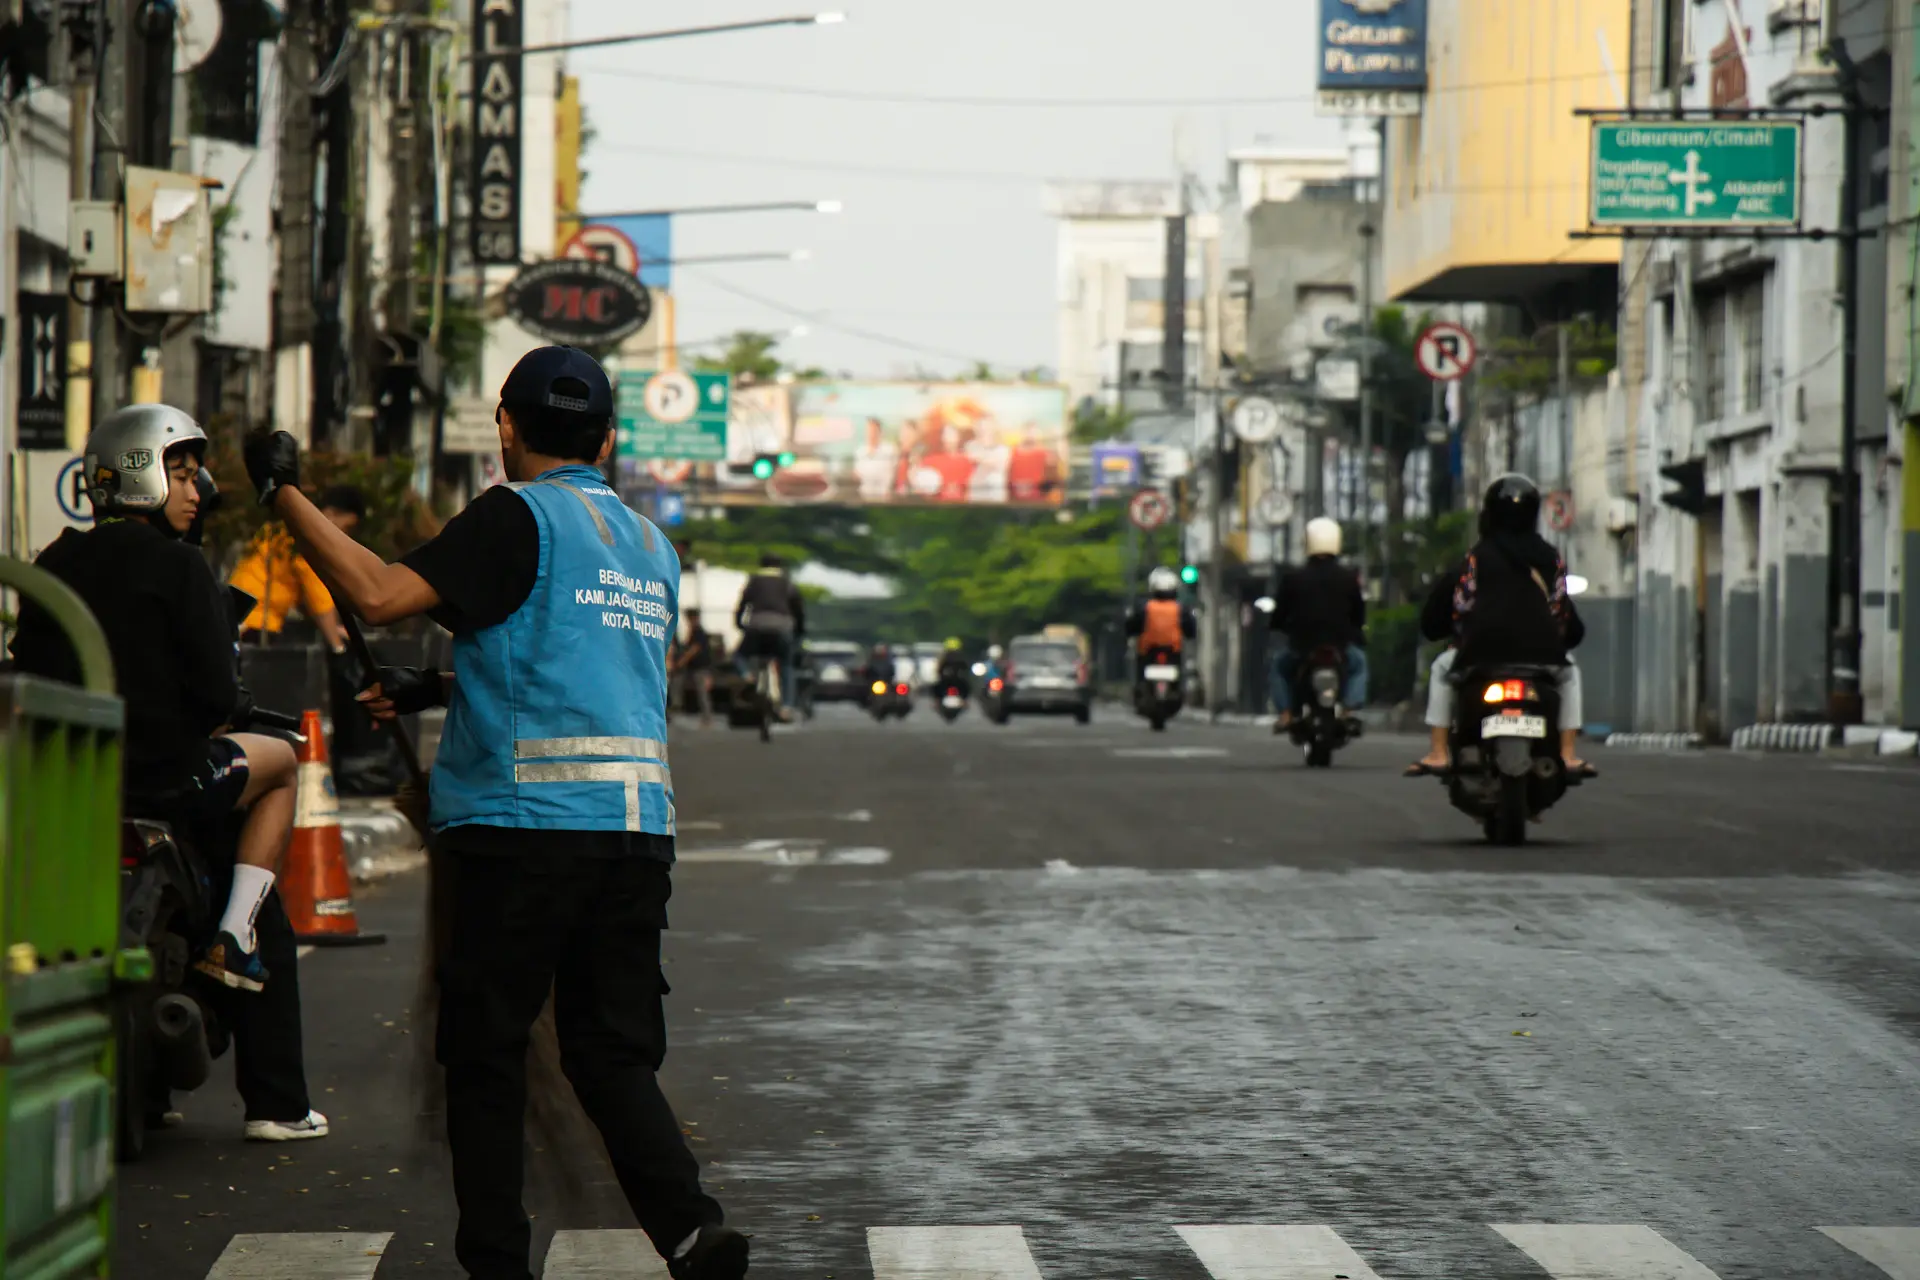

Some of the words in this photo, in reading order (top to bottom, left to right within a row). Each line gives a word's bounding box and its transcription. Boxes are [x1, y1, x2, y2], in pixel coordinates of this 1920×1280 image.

[575, 588, 606, 605] KAMI
[606, 591, 631, 609] JAG
[644, 580, 667, 599] AND
[601, 611, 632, 630] KOTA
